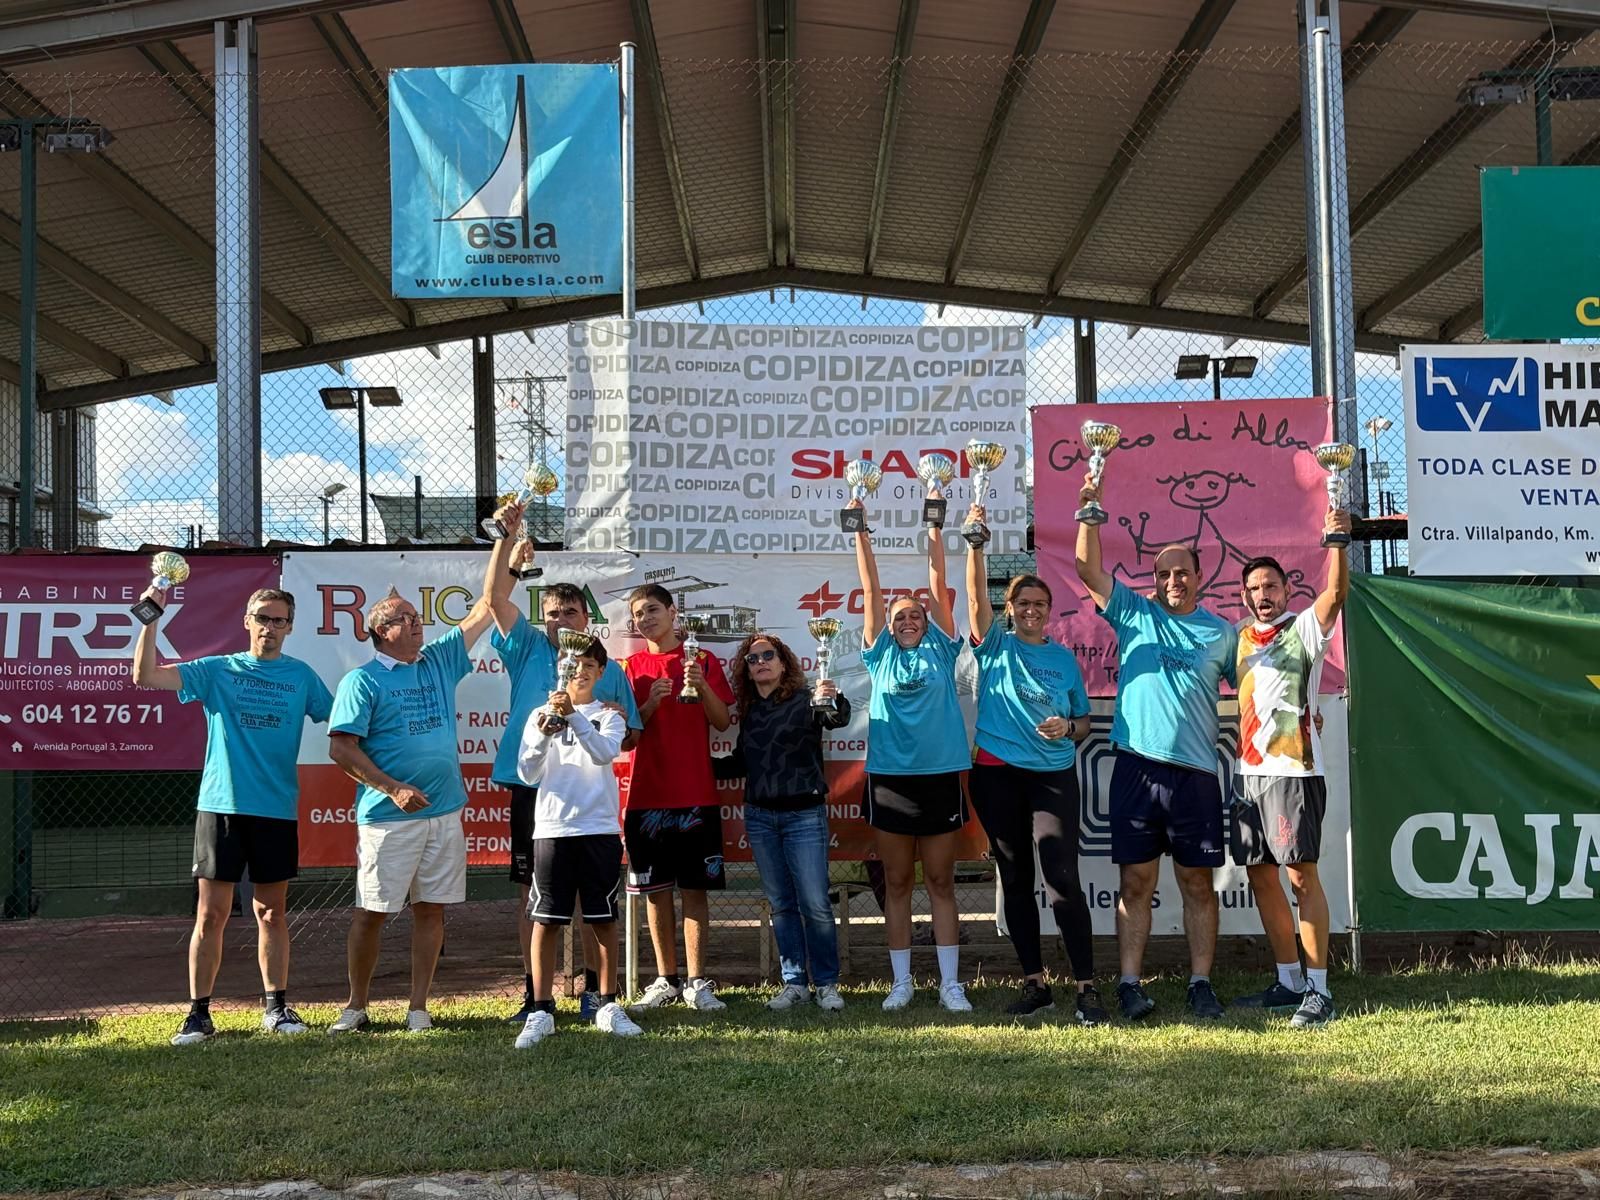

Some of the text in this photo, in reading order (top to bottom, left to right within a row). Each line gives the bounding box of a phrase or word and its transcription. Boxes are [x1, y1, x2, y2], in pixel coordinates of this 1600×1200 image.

[467, 219, 558, 249] esla
[465, 254, 561, 264] CLUB DEPORTIVO
[415, 273, 604, 288] www.clubesla.com
[567, 320, 734, 350] COPIDIZA
[735, 328, 848, 348] COPIDIZA
[849, 334, 914, 345] COPIDIZA
[675, 359, 741, 373] COPIDIZA
[743, 354, 912, 382] COPIDIZA
[913, 358, 1025, 377] COPIDIZA
[627, 385, 740, 407] COPIDIZA
[742, 392, 808, 405] COPIDIZA
[810, 385, 978, 413] COPIDIZA
[1545, 399, 1600, 428] MA
[664, 412, 833, 439] COPIDIZA
[835, 417, 948, 437] COPIDIZA
[950, 421, 1016, 433] COPIDIZA
[565, 440, 733, 470] COPIDIZA
[1417, 458, 1597, 476] TODA CLASE D
[674, 478, 741, 491] COPIDIZA
[791, 485, 879, 499] Divisin
[1520, 488, 1600, 506] VENTA
[626, 502, 740, 524] COPIDIZA
[741, 509, 808, 521] COPIDIZA
[565, 527, 733, 553] COPIDIZA
[733, 532, 849, 552] COPIDIZA
[849, 537, 914, 548] CPIDIZA
[1421, 526, 1595, 544] Ctra. Villalpando, Km.
[0, 586, 185, 600] ABINEE
[0, 661, 72, 676] luciones
[66, 680, 124, 691] ABOGADOS
[22, 704, 164, 724] 604 12 76 71
[33, 742, 154, 754] Avenida Portugal 3, Zamora
[1390, 811, 1600, 906] CAJA
